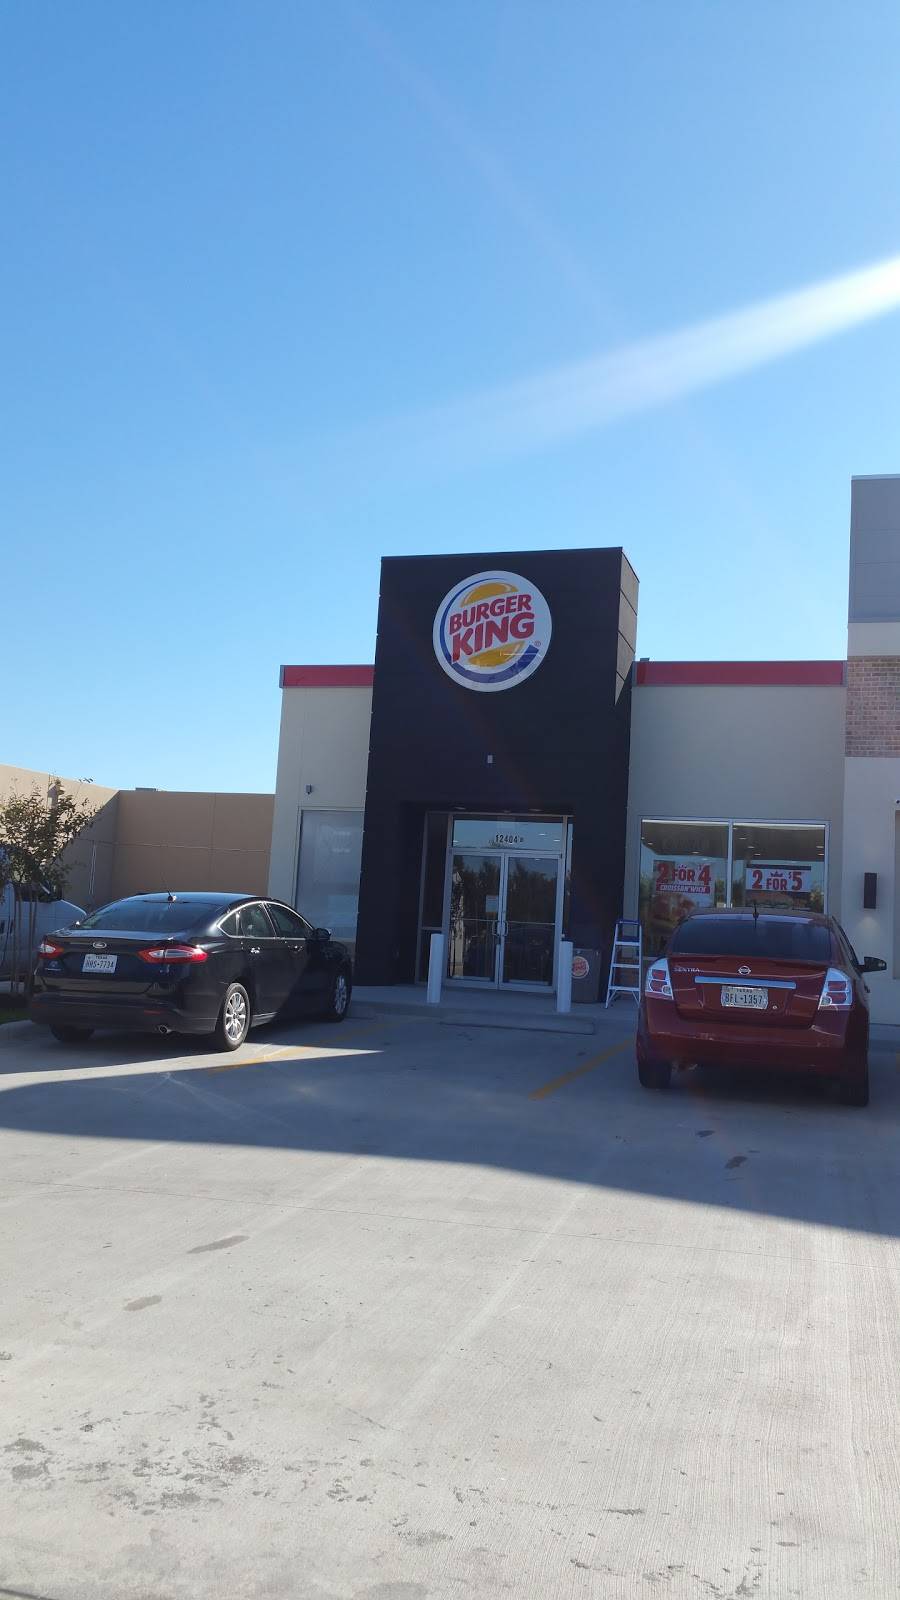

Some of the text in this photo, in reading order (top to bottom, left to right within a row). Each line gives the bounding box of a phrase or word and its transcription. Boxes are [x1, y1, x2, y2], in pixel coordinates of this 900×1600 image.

[449, 594, 531, 635] BURGER
[452, 612, 535, 662] KING
[656, 863, 669, 884] 2
[671, 868, 695, 882] FOR
[752, 870, 762, 889] 2
[766, 878, 787, 890] FOR
